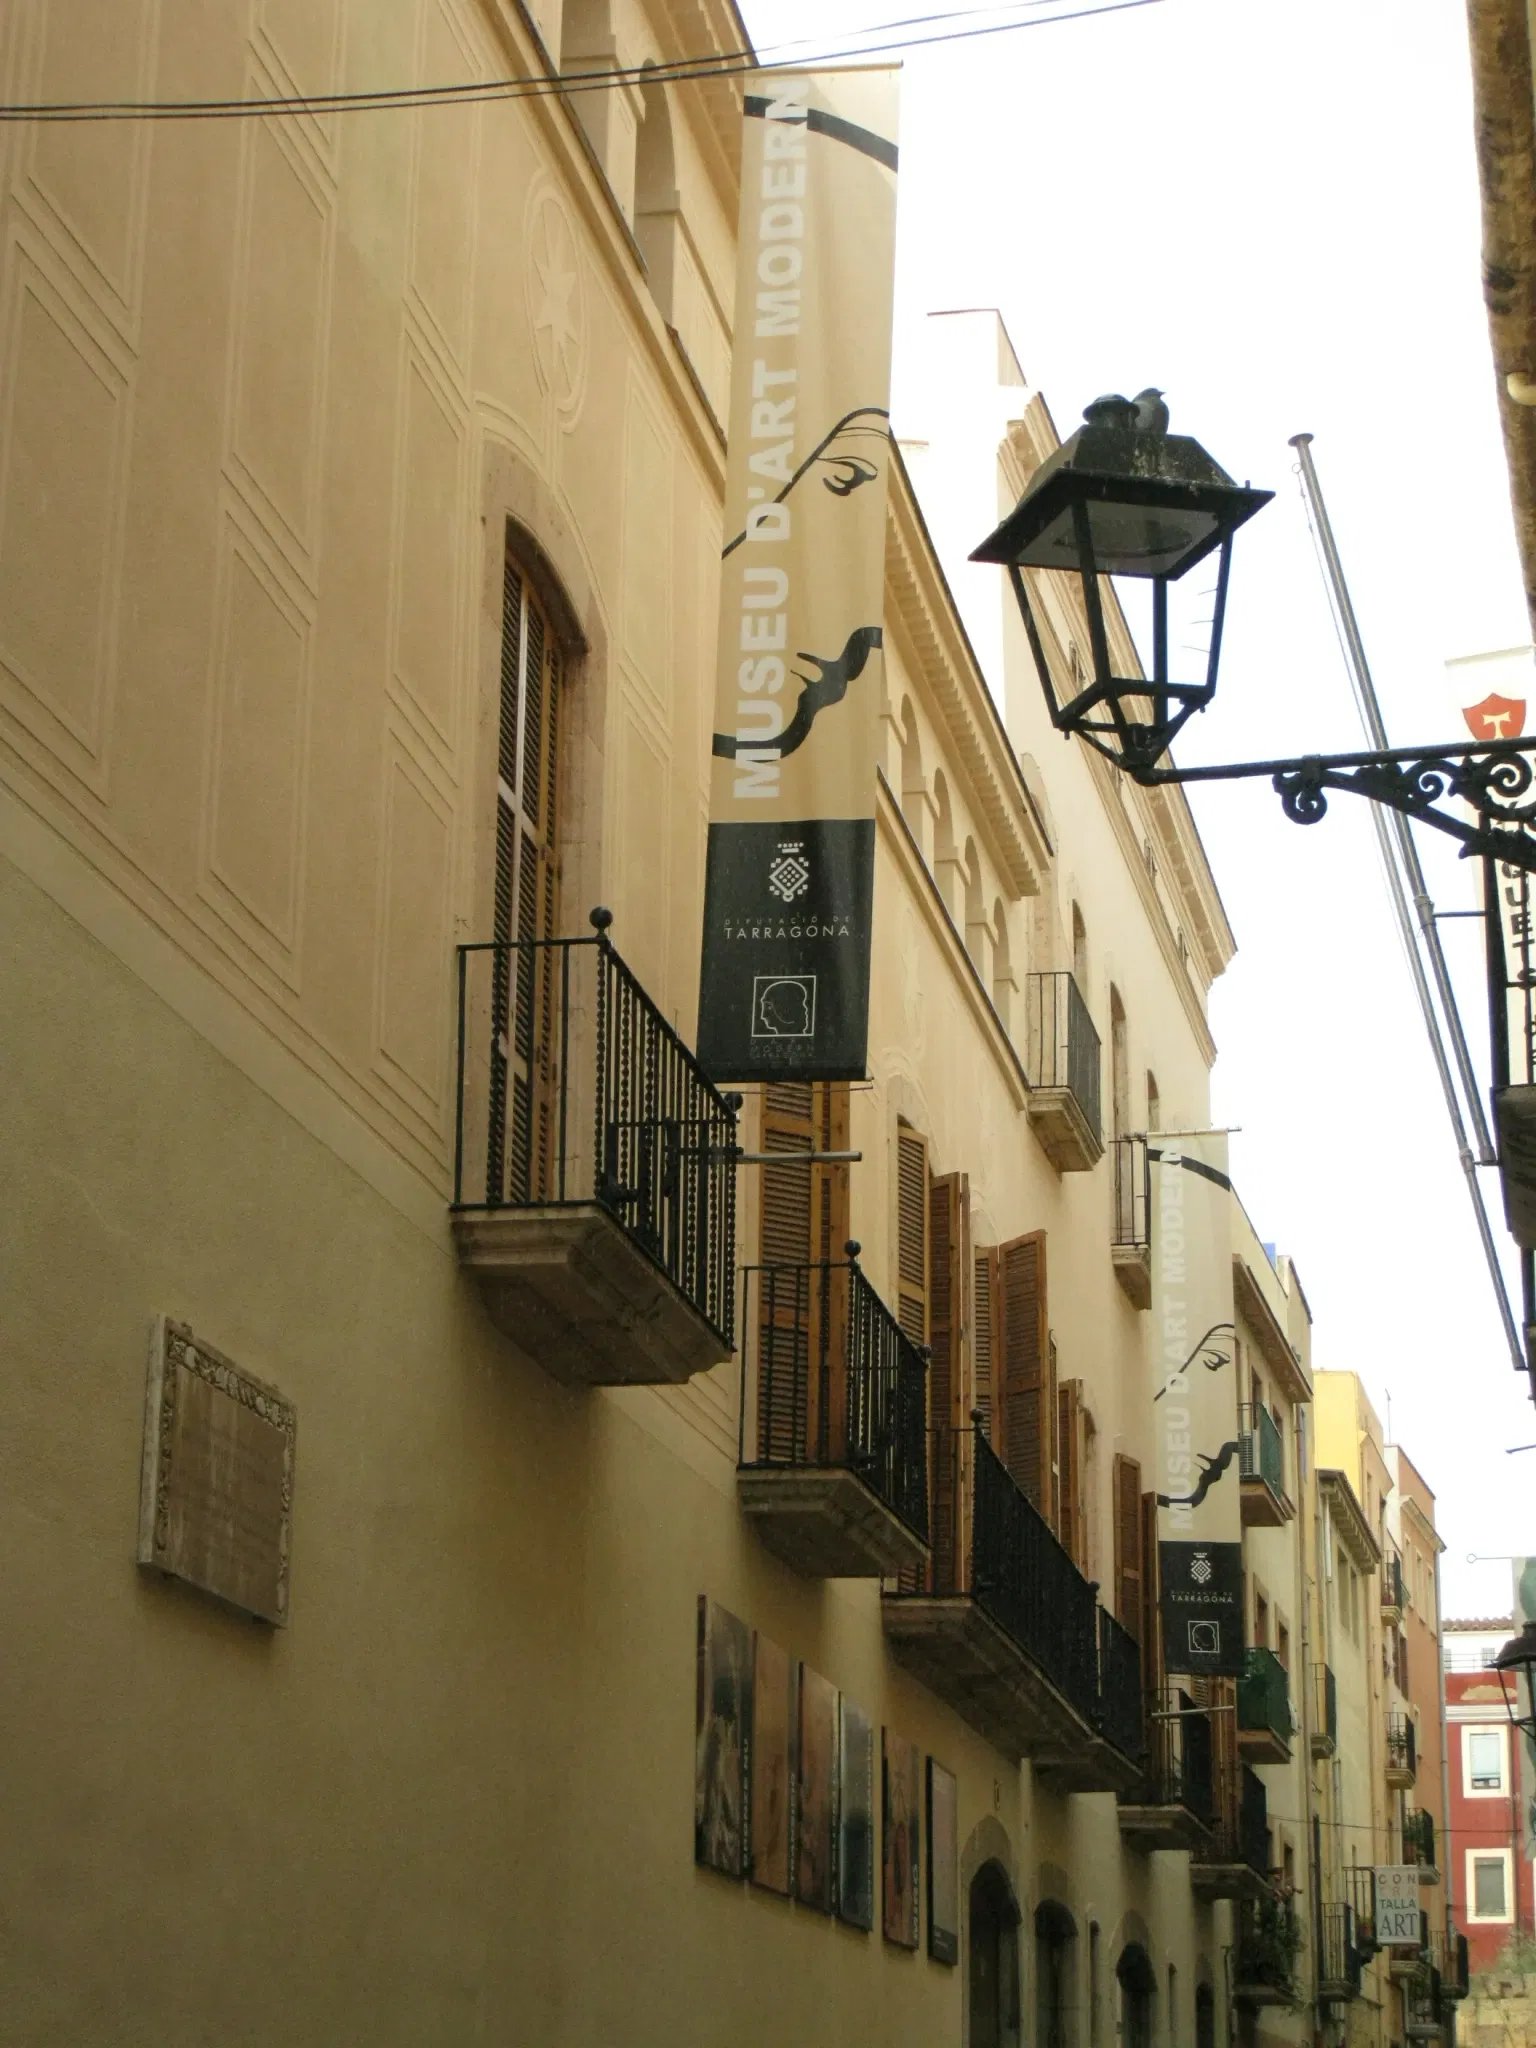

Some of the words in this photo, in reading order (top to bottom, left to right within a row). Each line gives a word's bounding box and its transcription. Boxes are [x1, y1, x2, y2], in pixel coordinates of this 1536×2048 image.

[755, 77, 810, 337] MODERN
[745, 359, 797, 541] D'ART
[734, 567, 789, 798] MUSEU
[724, 925, 850, 939] TARRAGONA
[1160, 1140, 1187, 1283] MODERN
[1163, 1294, 1189, 1393] D'ART
[1166, 1407, 1192, 1530] MUSEU
[1171, 1594, 1234, 1603] TARRAGONA
[1378, 1873, 1416, 1885] CON
[1379, 1912, 1418, 1937] ART
[1380, 1898, 1417, 1909] TALLA
